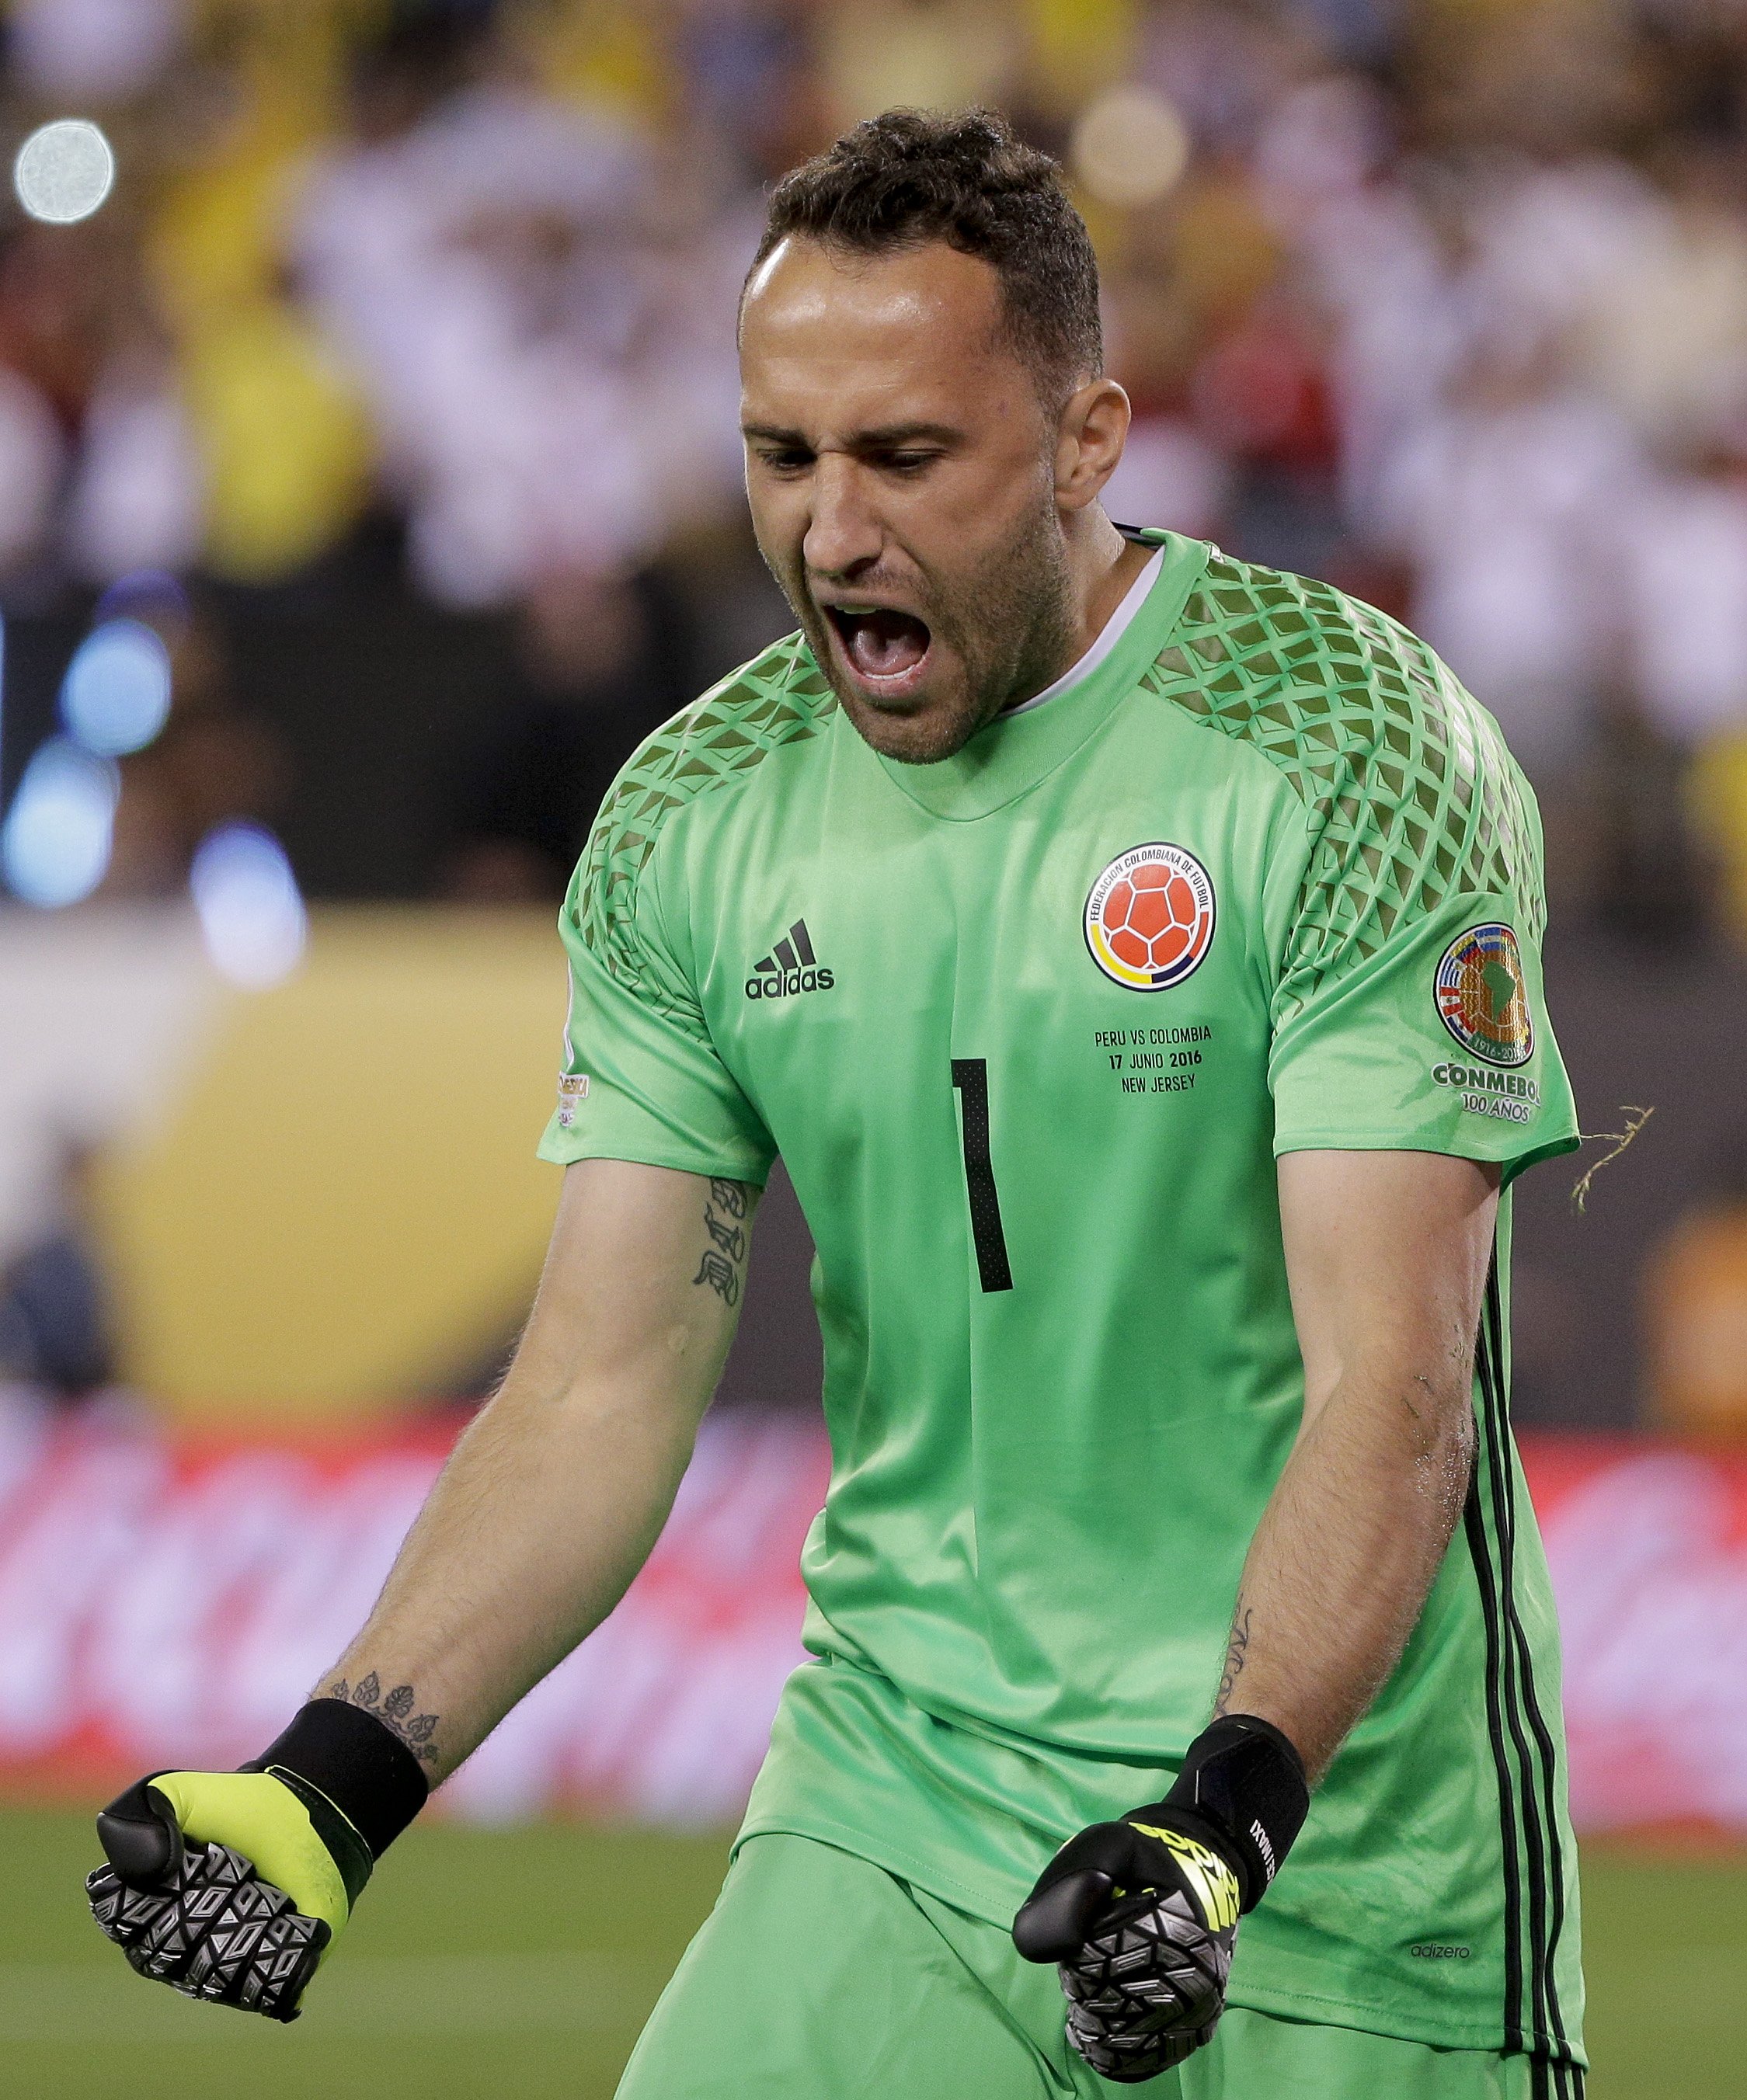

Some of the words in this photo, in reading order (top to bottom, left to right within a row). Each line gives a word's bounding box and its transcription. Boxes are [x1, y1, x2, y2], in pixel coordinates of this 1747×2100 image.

[1090, 864, 1124, 921] FEDERACION
[1124, 849, 1181, 867] COLOMBIANA
[1180, 860, 1194, 875] DE
[1189, 872, 1209, 909] FUTBOL
[745, 966, 835, 1000] adidas
[1094, 1030, 1126, 1047] PERU
[1129, 1029, 1146, 1045] VS
[1150, 1025, 1212, 1045] COLOMBIA
[1108, 1054, 1122, 1070] 17
[1129, 1053, 1164, 1069] JUNIO
[1169, 1050, 1202, 1068] 2016
[1121, 1077, 1146, 1093] NEW
[1150, 1073, 1195, 1093] JERSEY
[1462, 1093, 1488, 1113] 100
[1489, 1097, 1529, 1122] AÑOS
[951, 1059, 1014, 1294] 1
[1411, 1943, 1470, 1959] adizero
